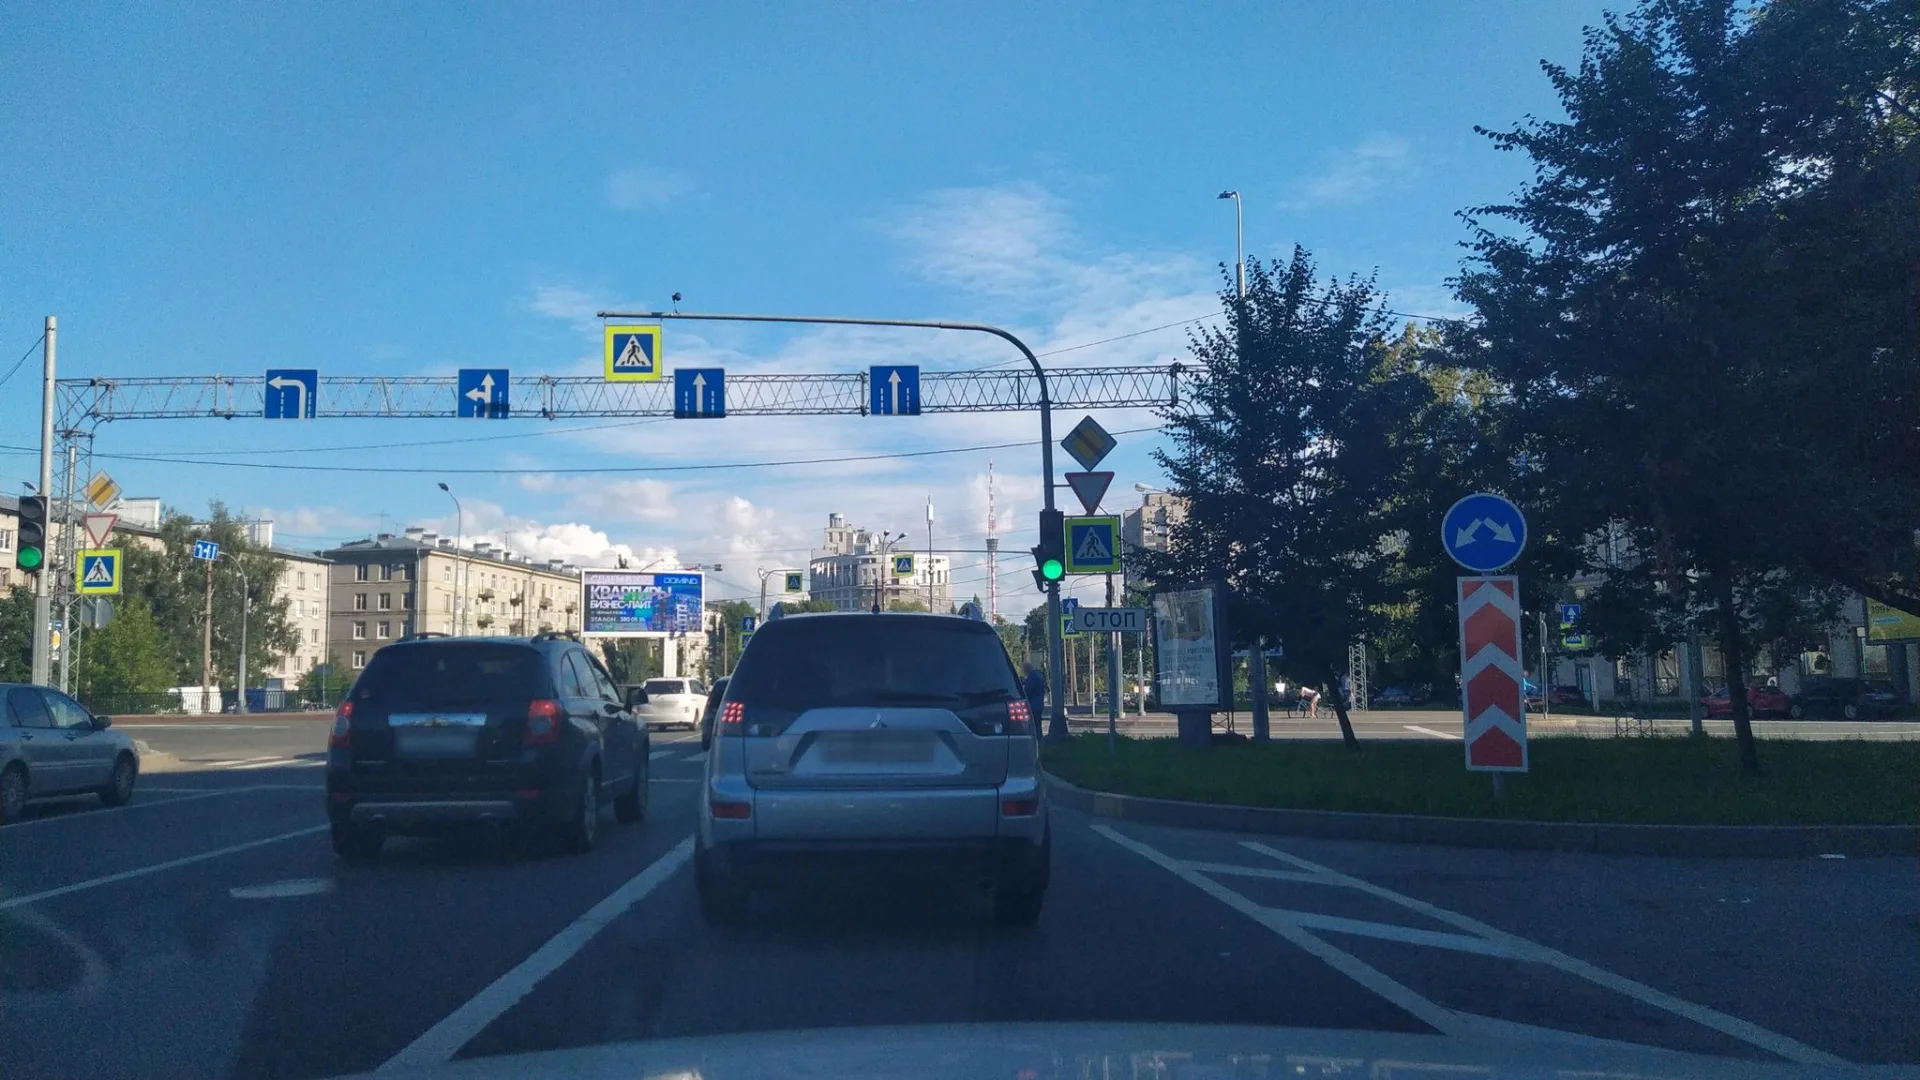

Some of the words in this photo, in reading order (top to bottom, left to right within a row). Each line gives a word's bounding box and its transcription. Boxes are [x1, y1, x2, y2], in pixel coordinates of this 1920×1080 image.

[663, 576, 698, 584] DOMINO
[590, 585, 672, 600] КВАРТИРЫ
[1083, 611, 1136, 628] СТОП
